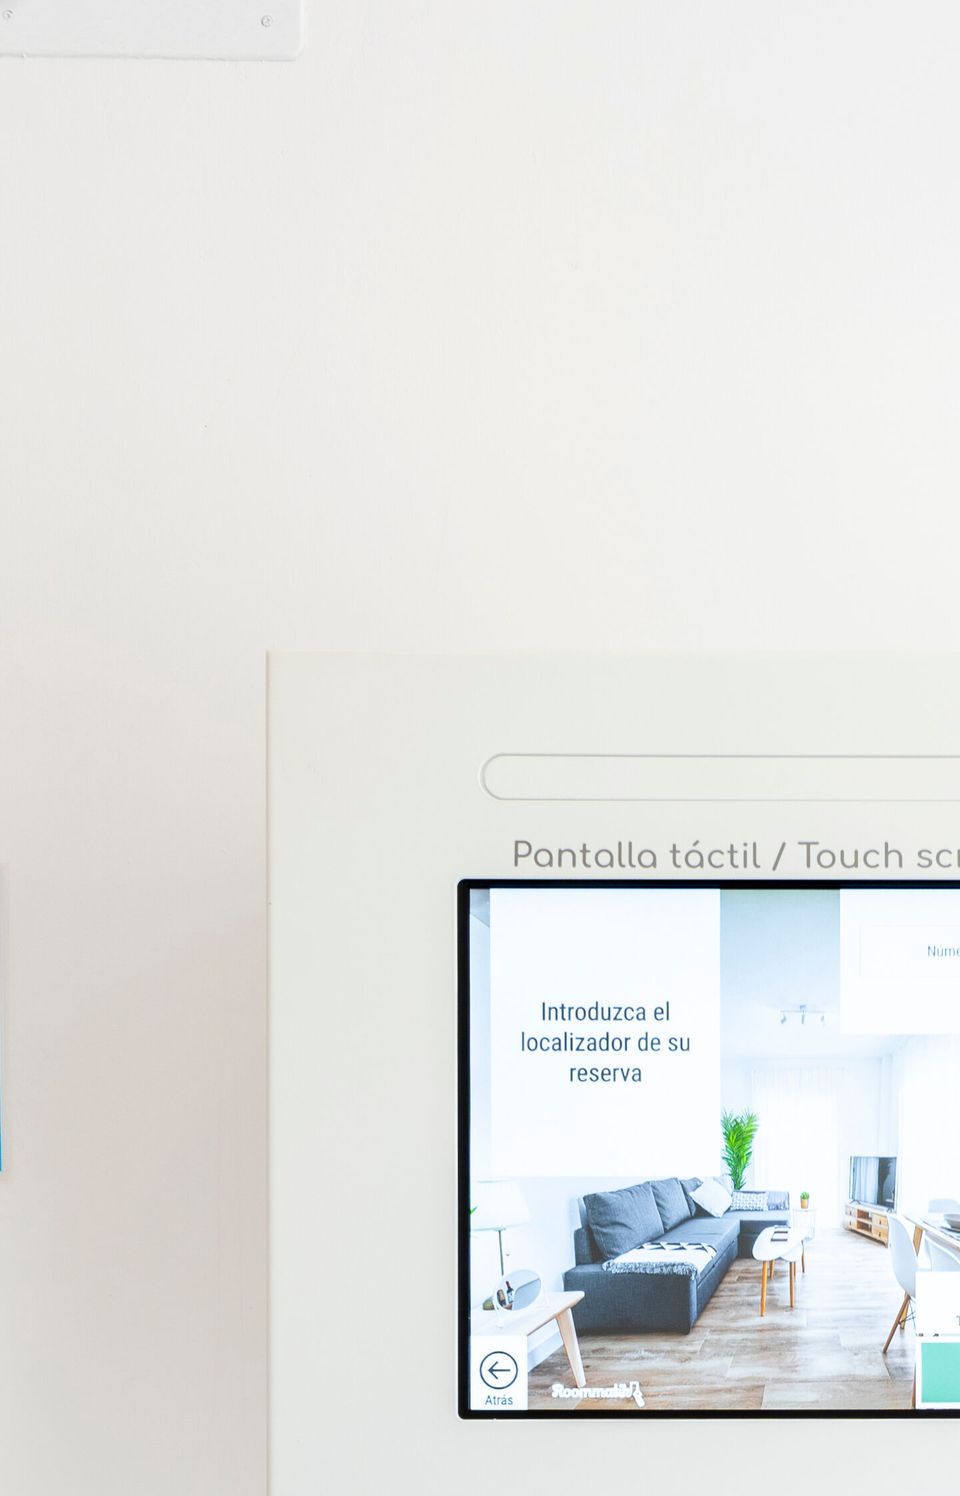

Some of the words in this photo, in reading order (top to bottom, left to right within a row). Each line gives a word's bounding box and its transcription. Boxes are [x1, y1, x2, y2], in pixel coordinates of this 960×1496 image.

[513, 839, 657, 869] Pantalla
[669, 839, 761, 869] táctil
[771, 841, 787, 872] /
[797, 841, 903, 870] Touch
[541, 1000, 647, 1022] Introduzca
[653, 1000, 670, 1022] el
[521, 1031, 632, 1052] localizador
[637, 1031, 661, 1052] de
[667, 1036, 690, 1052] su
[569, 1067, 642, 1083] reserva
[484, 1393, 514, 1406] Atrás
